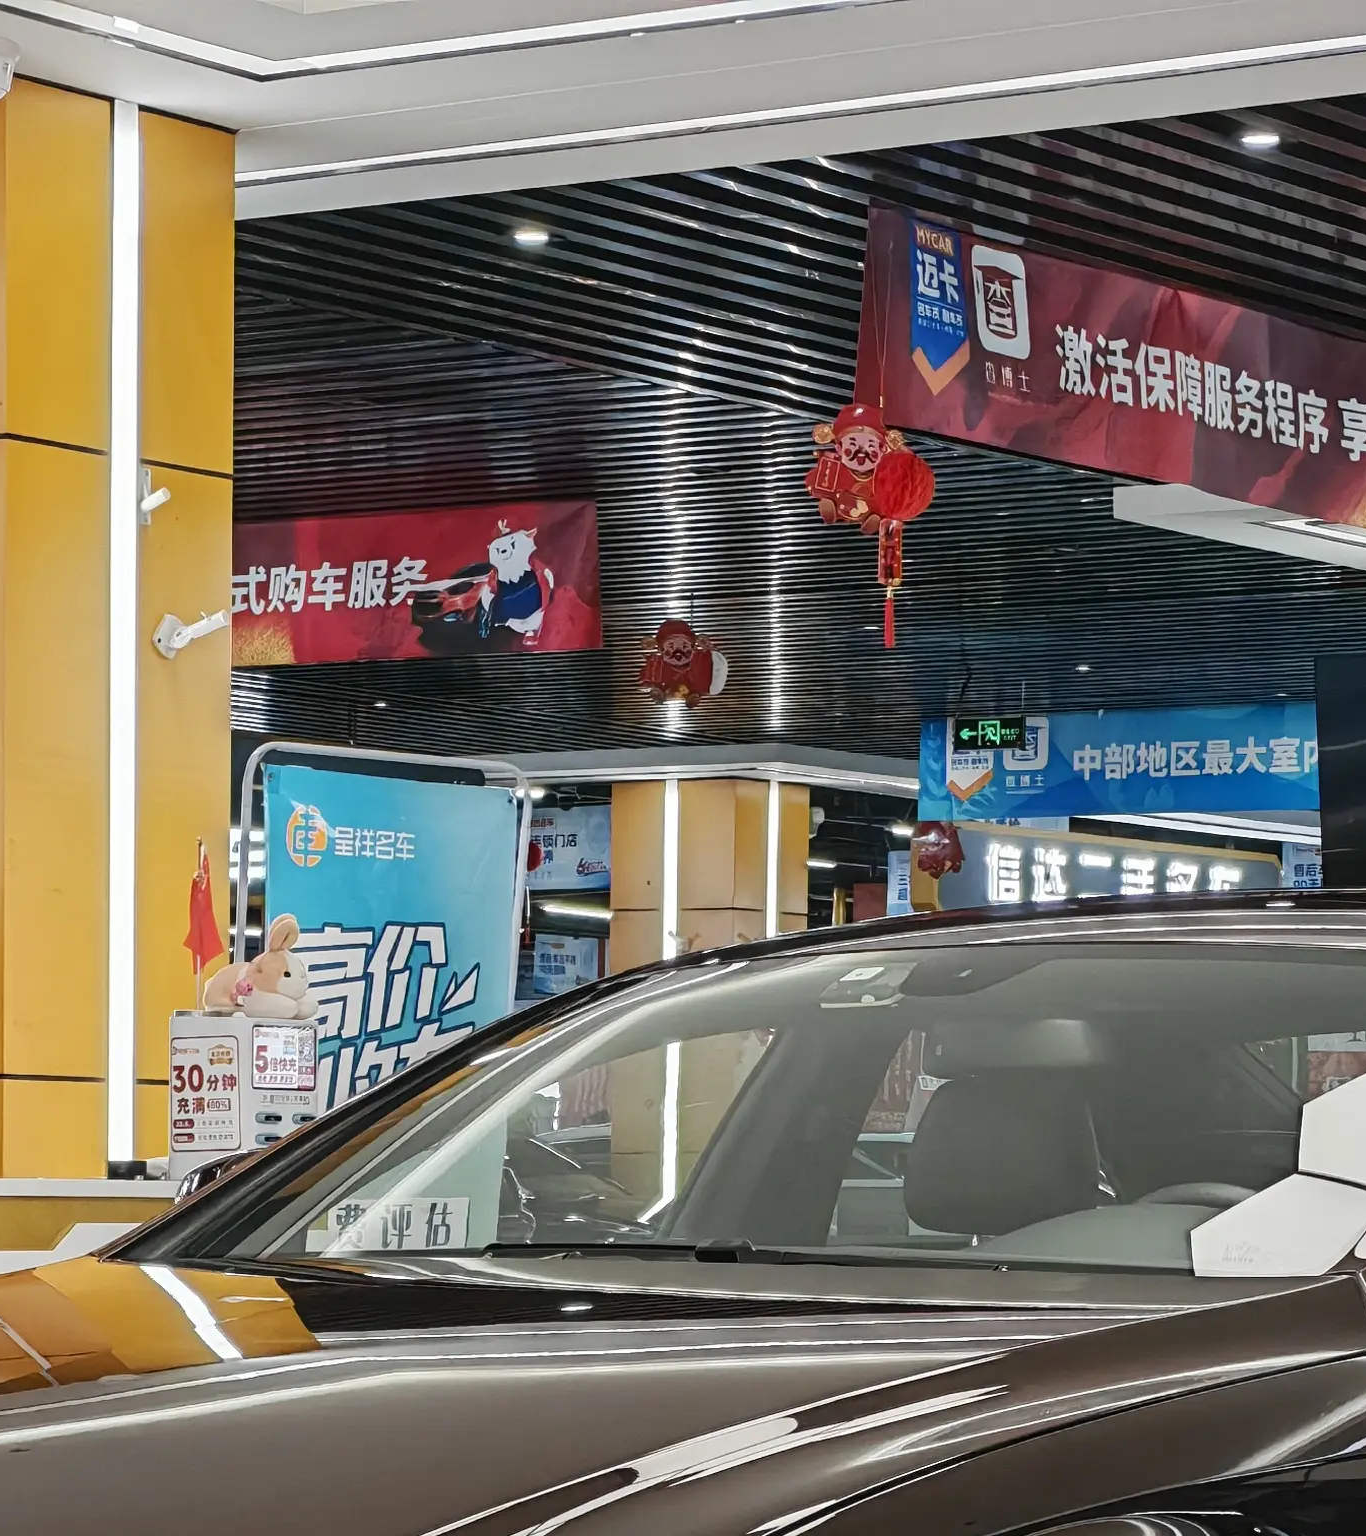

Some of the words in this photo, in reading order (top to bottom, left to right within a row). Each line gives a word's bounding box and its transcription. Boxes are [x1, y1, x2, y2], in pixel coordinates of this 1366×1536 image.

[916, 225, 954, 256] MYCAR
[916, 250, 959, 304] 迈卡
[1055, 325, 1329, 455] 激活保障服务程序
[232, 556, 428, 615] 式购车服务
[334, 826, 416, 862] 呈祥名车
[296, 921, 450, 1043] 高价
[172, 1064, 237, 1094] 30分钟
[177, 1098, 206, 1115] 充满
